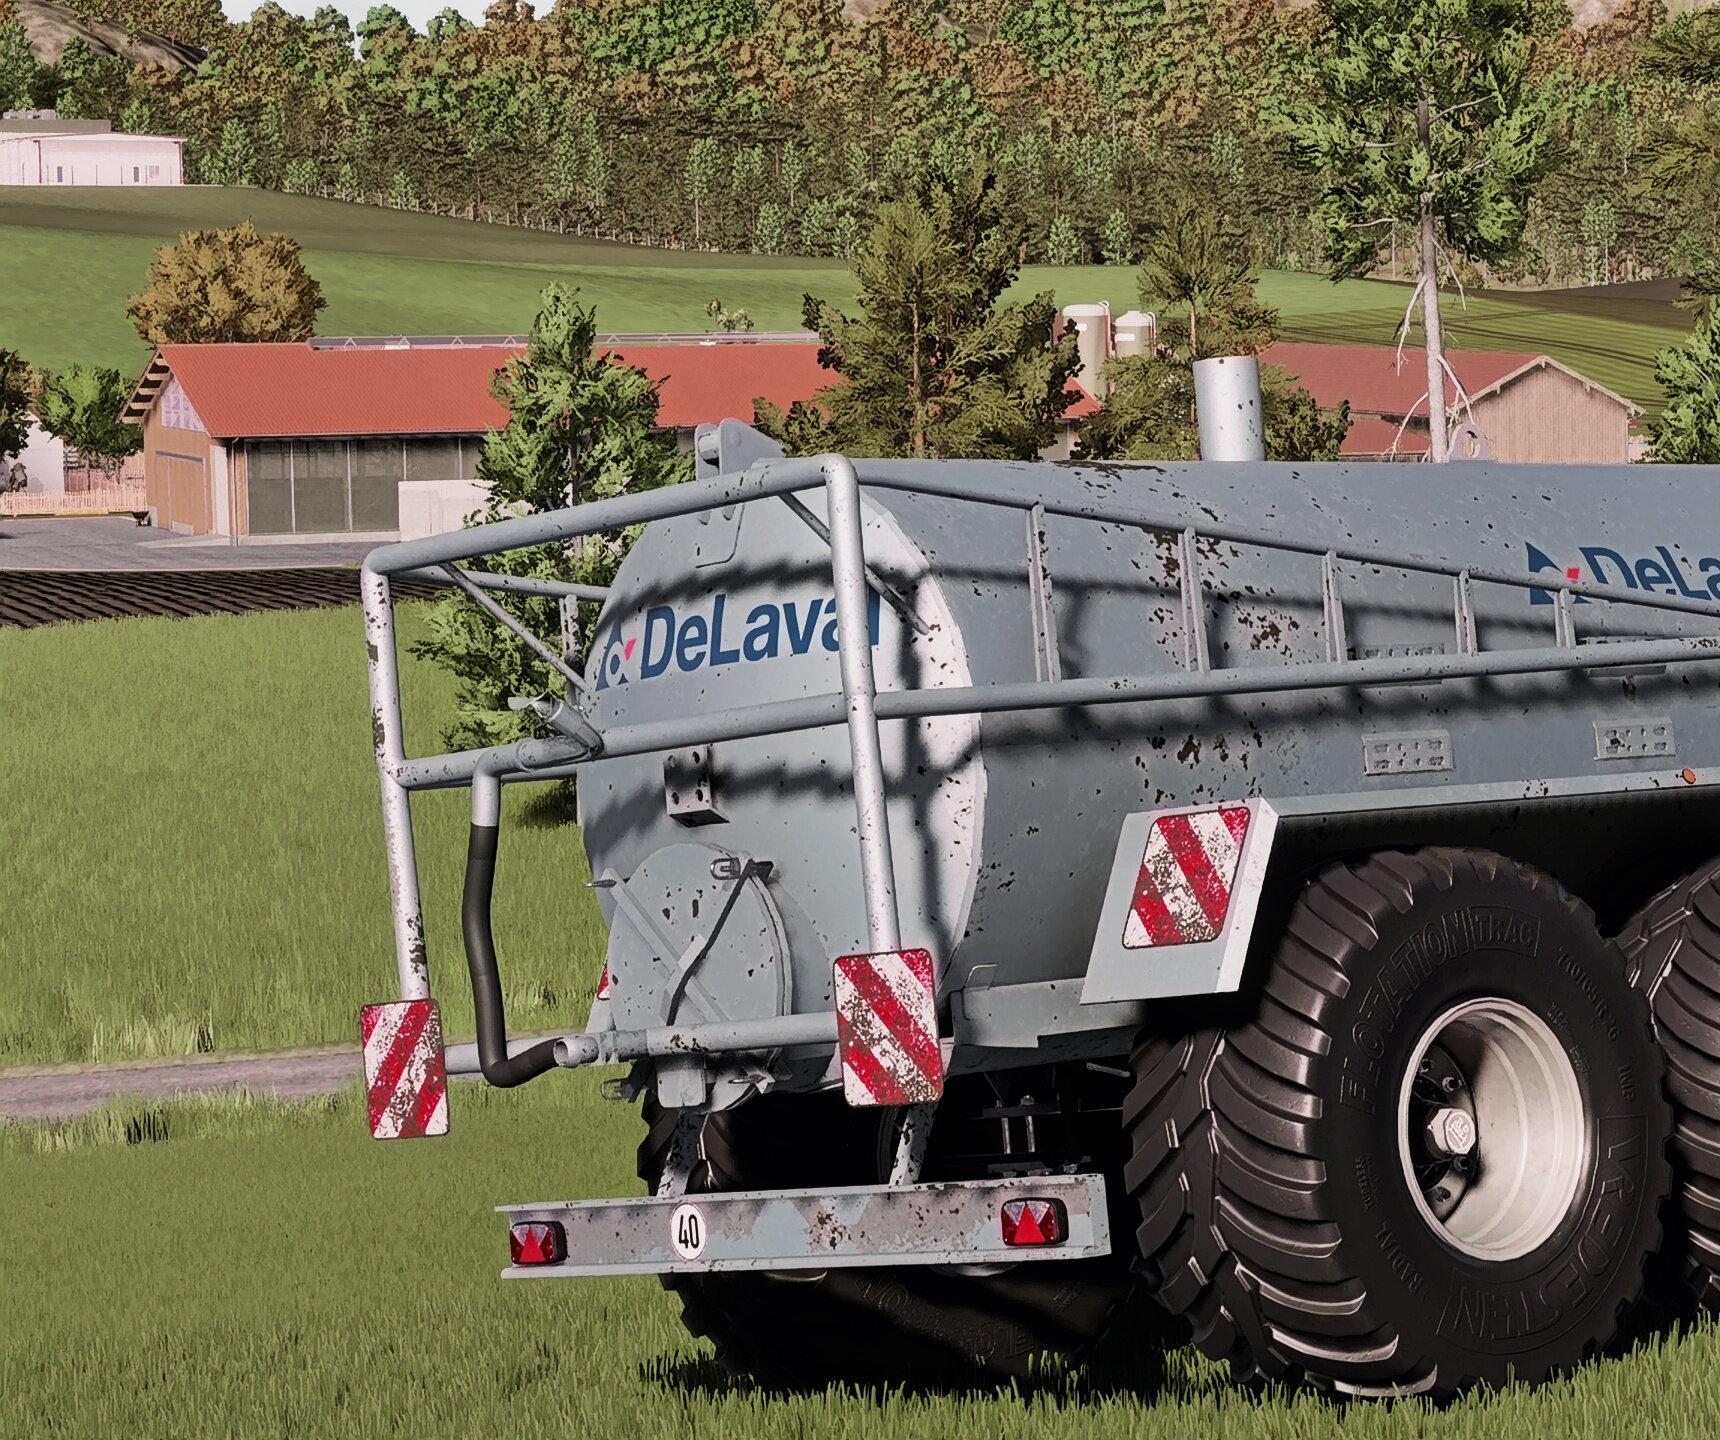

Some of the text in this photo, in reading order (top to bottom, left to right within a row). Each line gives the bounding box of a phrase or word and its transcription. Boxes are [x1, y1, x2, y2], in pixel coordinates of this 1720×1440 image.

[1474, 912, 1534, 946] TRAC
[678, 1214, 700, 1249] 40
[1374, 1220, 1426, 1298] RADIAL
[1451, 1130, 1643, 1344] VREDESTEIN
